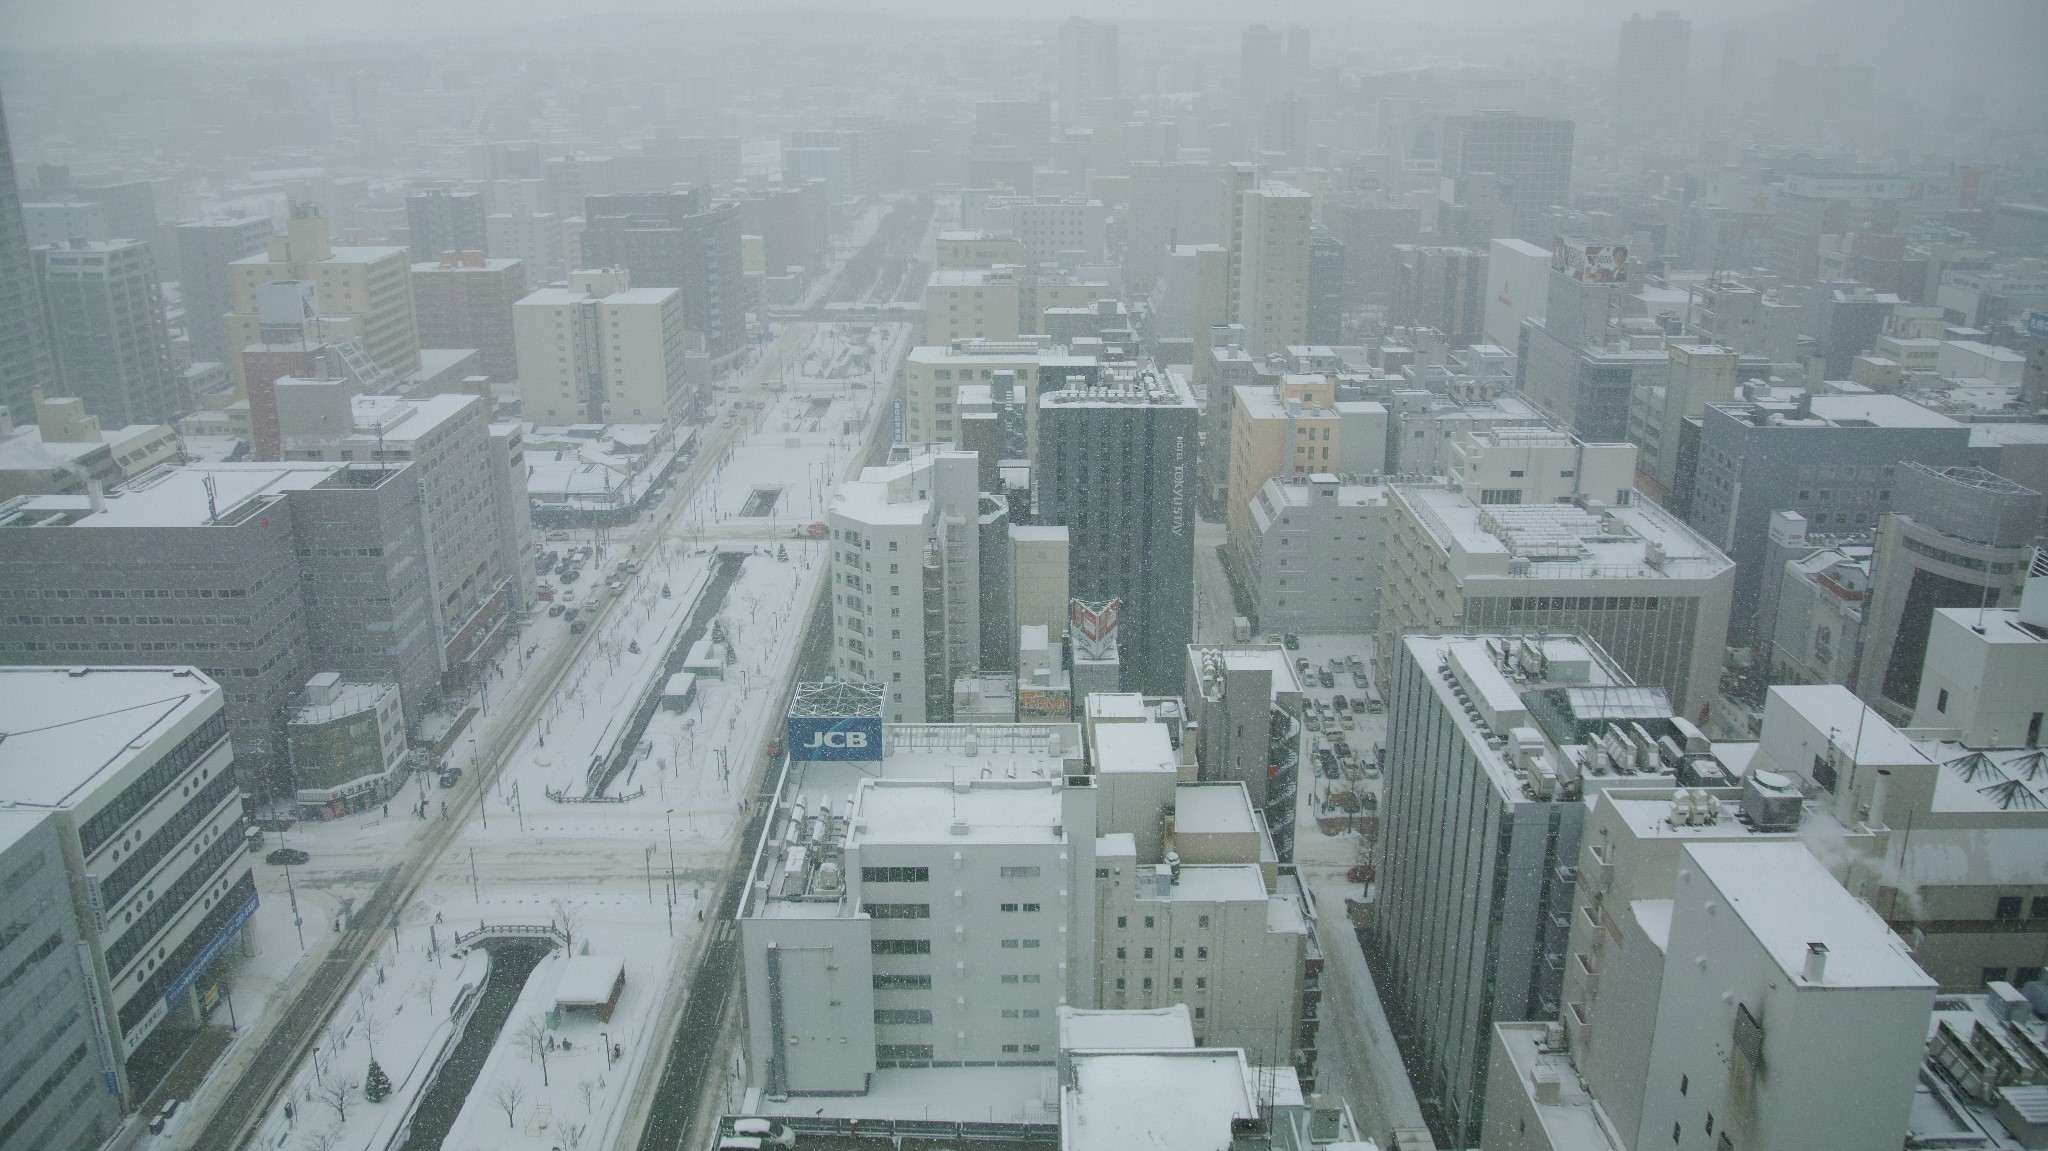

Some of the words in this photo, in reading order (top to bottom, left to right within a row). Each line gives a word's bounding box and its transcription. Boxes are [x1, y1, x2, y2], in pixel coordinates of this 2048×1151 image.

[1176, 436, 1184, 461] HOTEL
[1173, 464, 1184, 506] TOKYU
[1172, 507, 1183, 537] STAY
[803, 731, 868, 748] JCB
